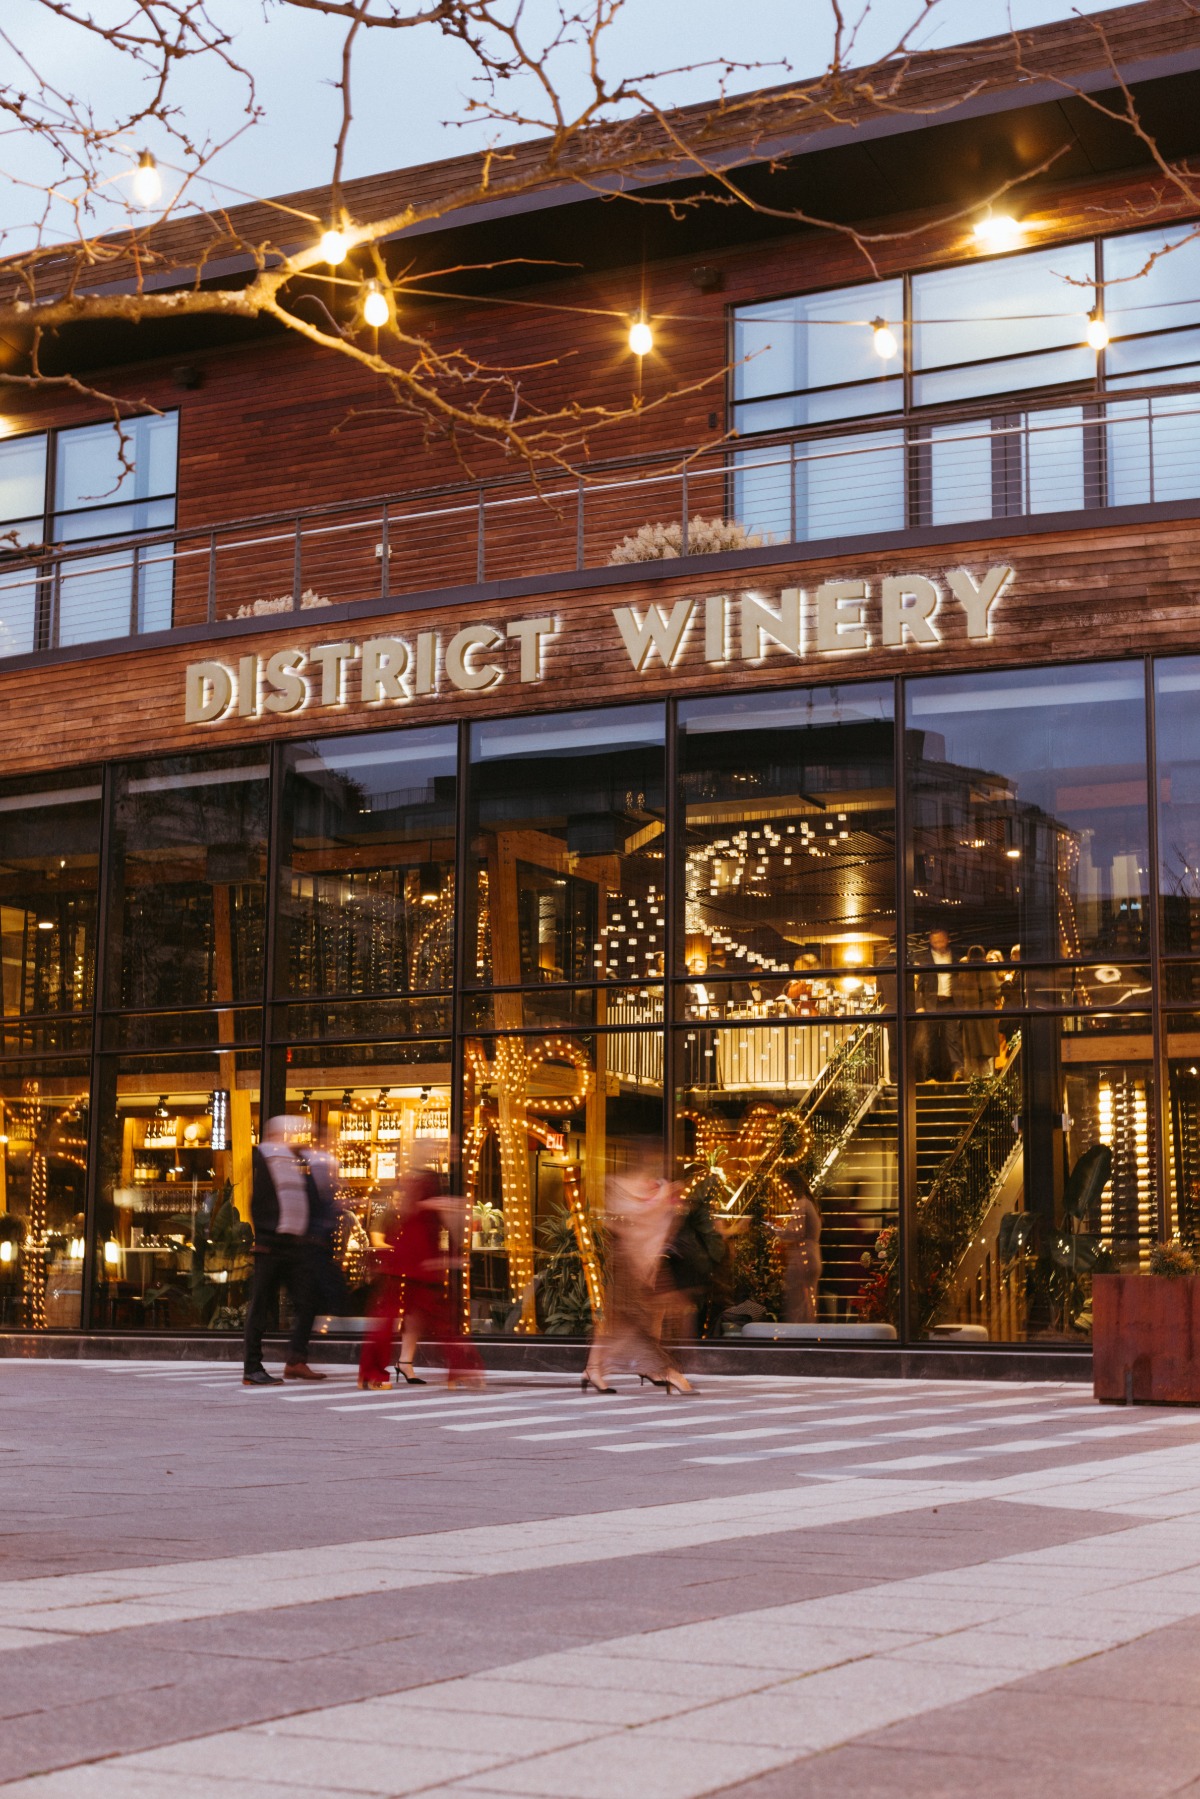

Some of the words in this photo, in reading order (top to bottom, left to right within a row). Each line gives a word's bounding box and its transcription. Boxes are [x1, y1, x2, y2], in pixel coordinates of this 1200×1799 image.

[184, 617, 557, 723] DISTRICT
[611, 566, 1014, 671] WINERY
[546, 1133, 564, 1149] EXIT
